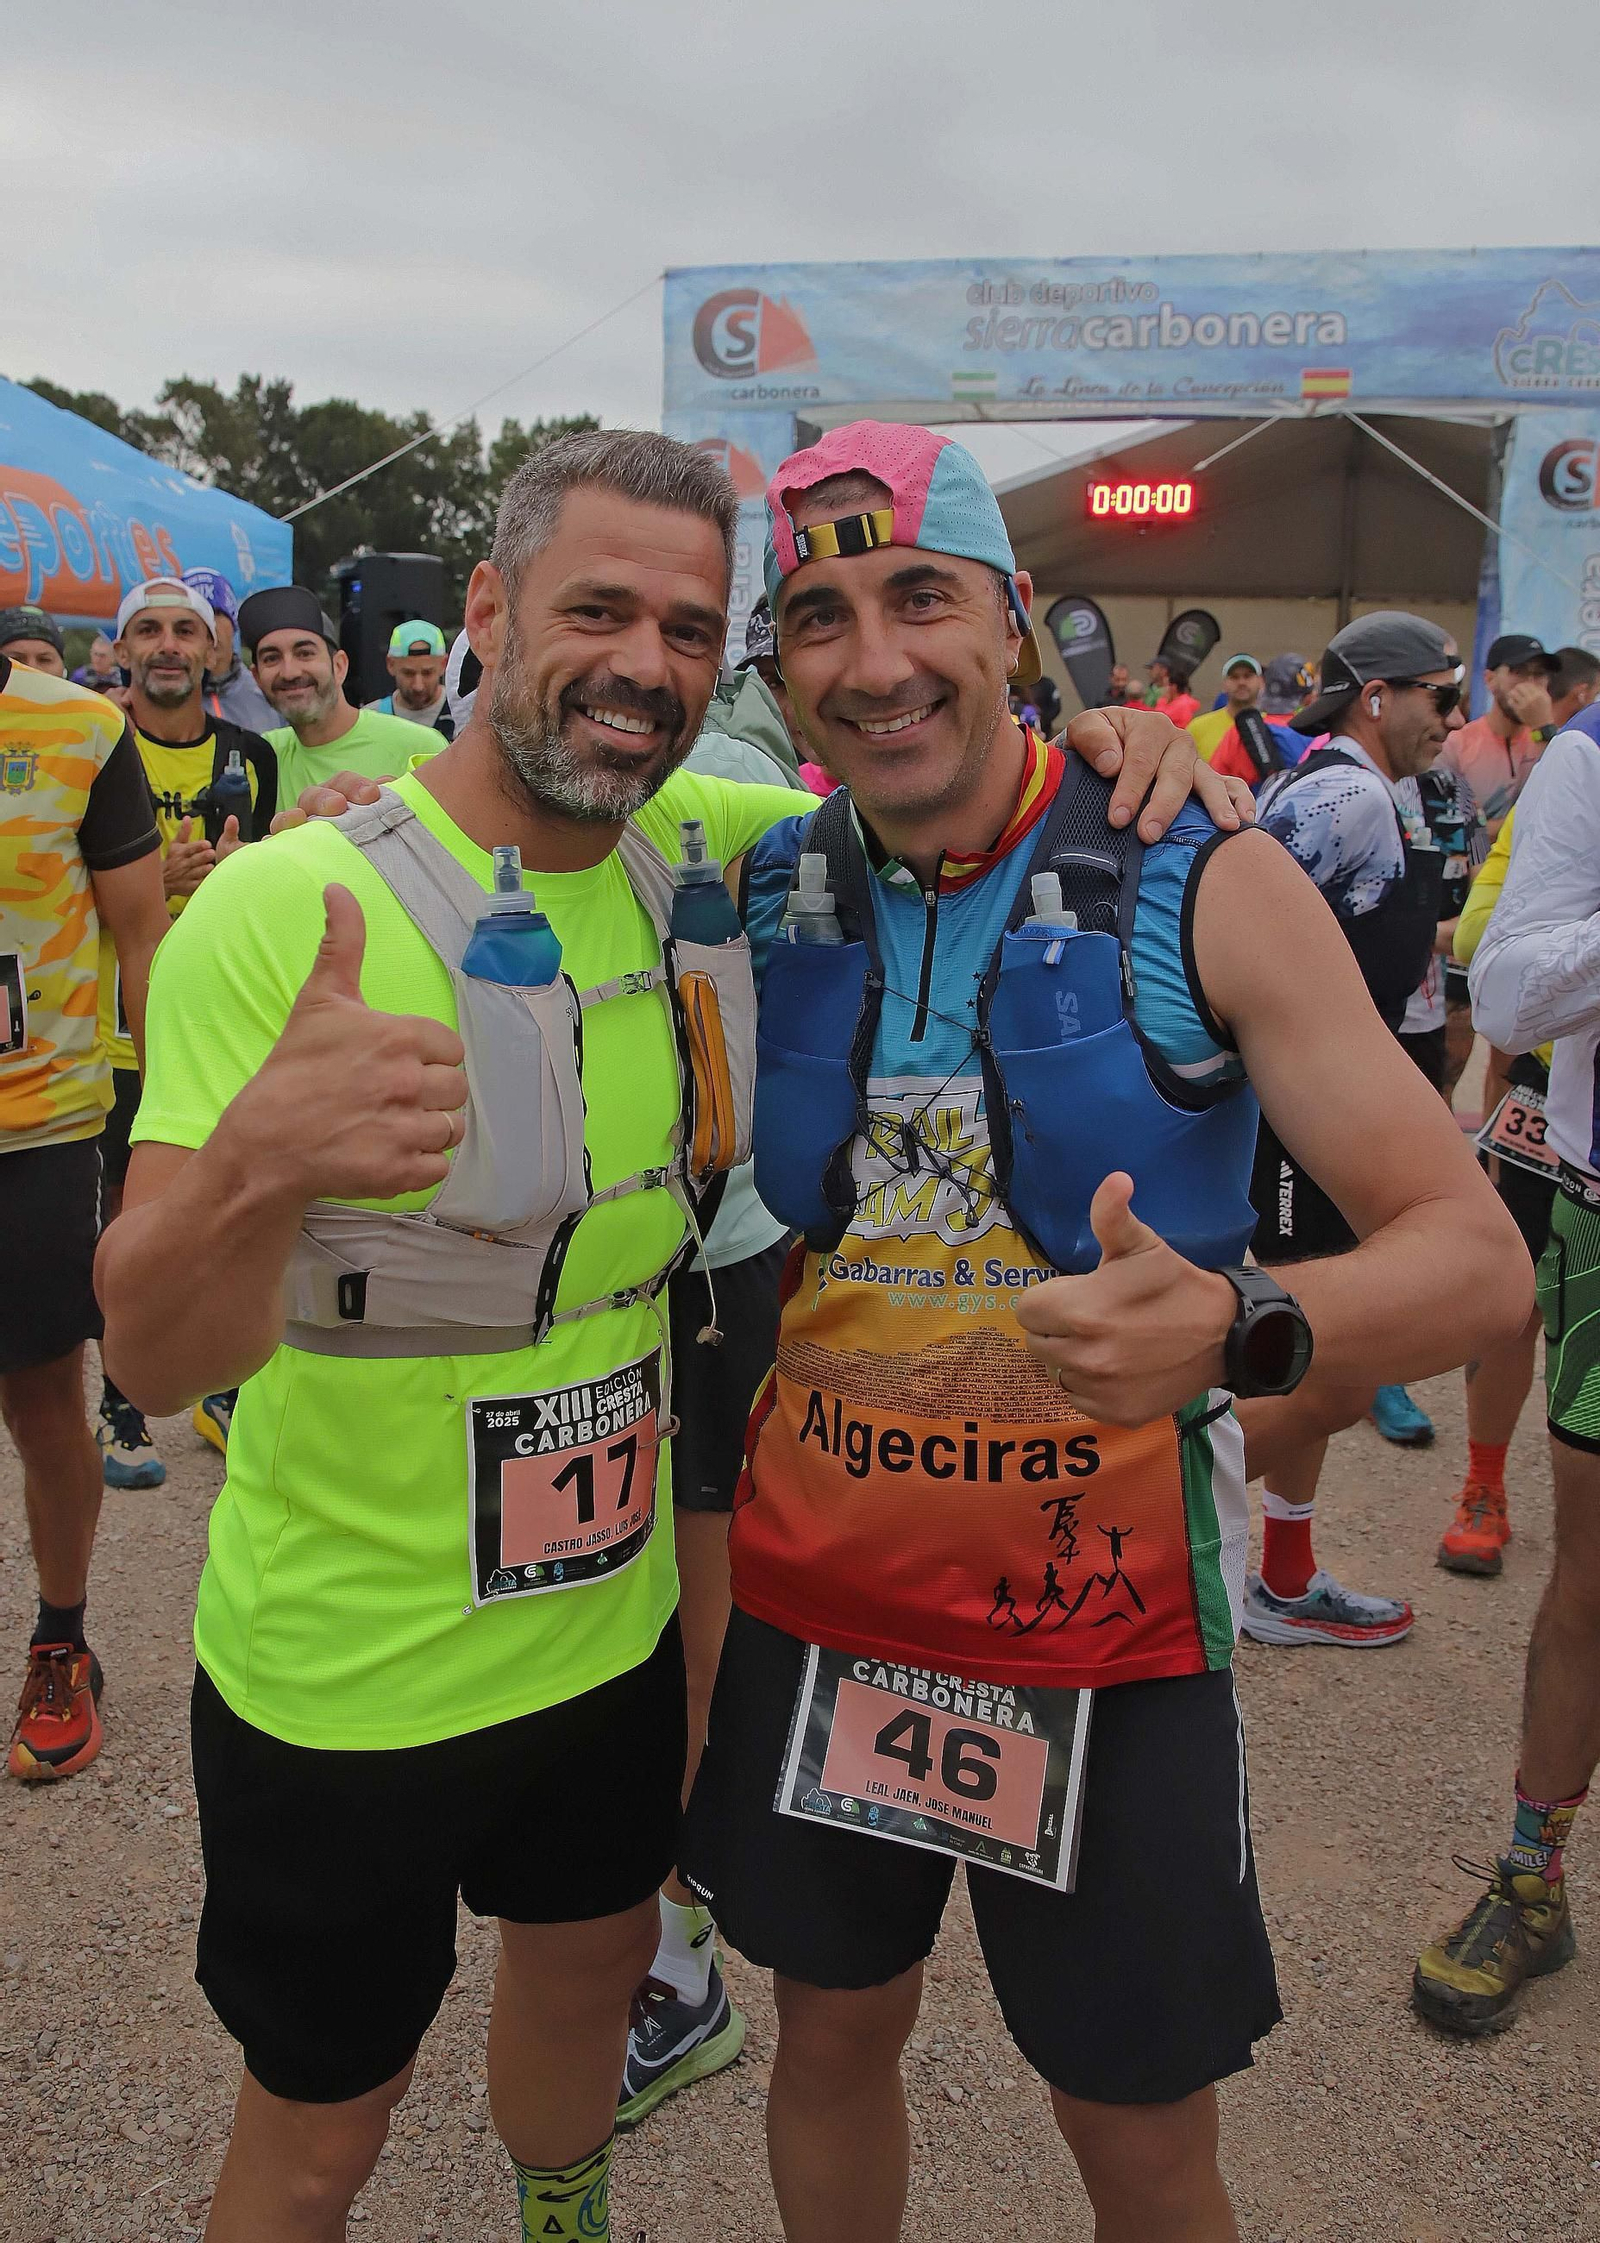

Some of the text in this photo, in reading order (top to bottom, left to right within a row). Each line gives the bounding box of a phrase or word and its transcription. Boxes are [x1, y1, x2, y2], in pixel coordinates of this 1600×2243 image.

[1092, 484, 1192, 514] 0:00:00
[1279, 1181, 1293, 1237] TERREX
[828, 1253, 945, 1289] Gabarras
[954, 1261, 975, 1286] &
[487, 1416, 520, 1428] 2025
[505, 1409, 521, 1417] abril
[514, 1391, 651, 1456] CARBONERA
[533, 1367, 642, 1430] XIII EDICIÓN
[596, 1380, 643, 1414] CRESTA
[799, 1390, 1101, 1483] Algeciras
[551, 1433, 637, 1525] 17
[543, 1538, 583, 1554] CASTRO
[615, 1520, 629, 1537] LUIS
[852, 1660, 1035, 1734] CARBONERA
[873, 1708, 1001, 1801] 46
[865, 1779, 993, 1830] LEAL JAEN, JOSE MANUEL
